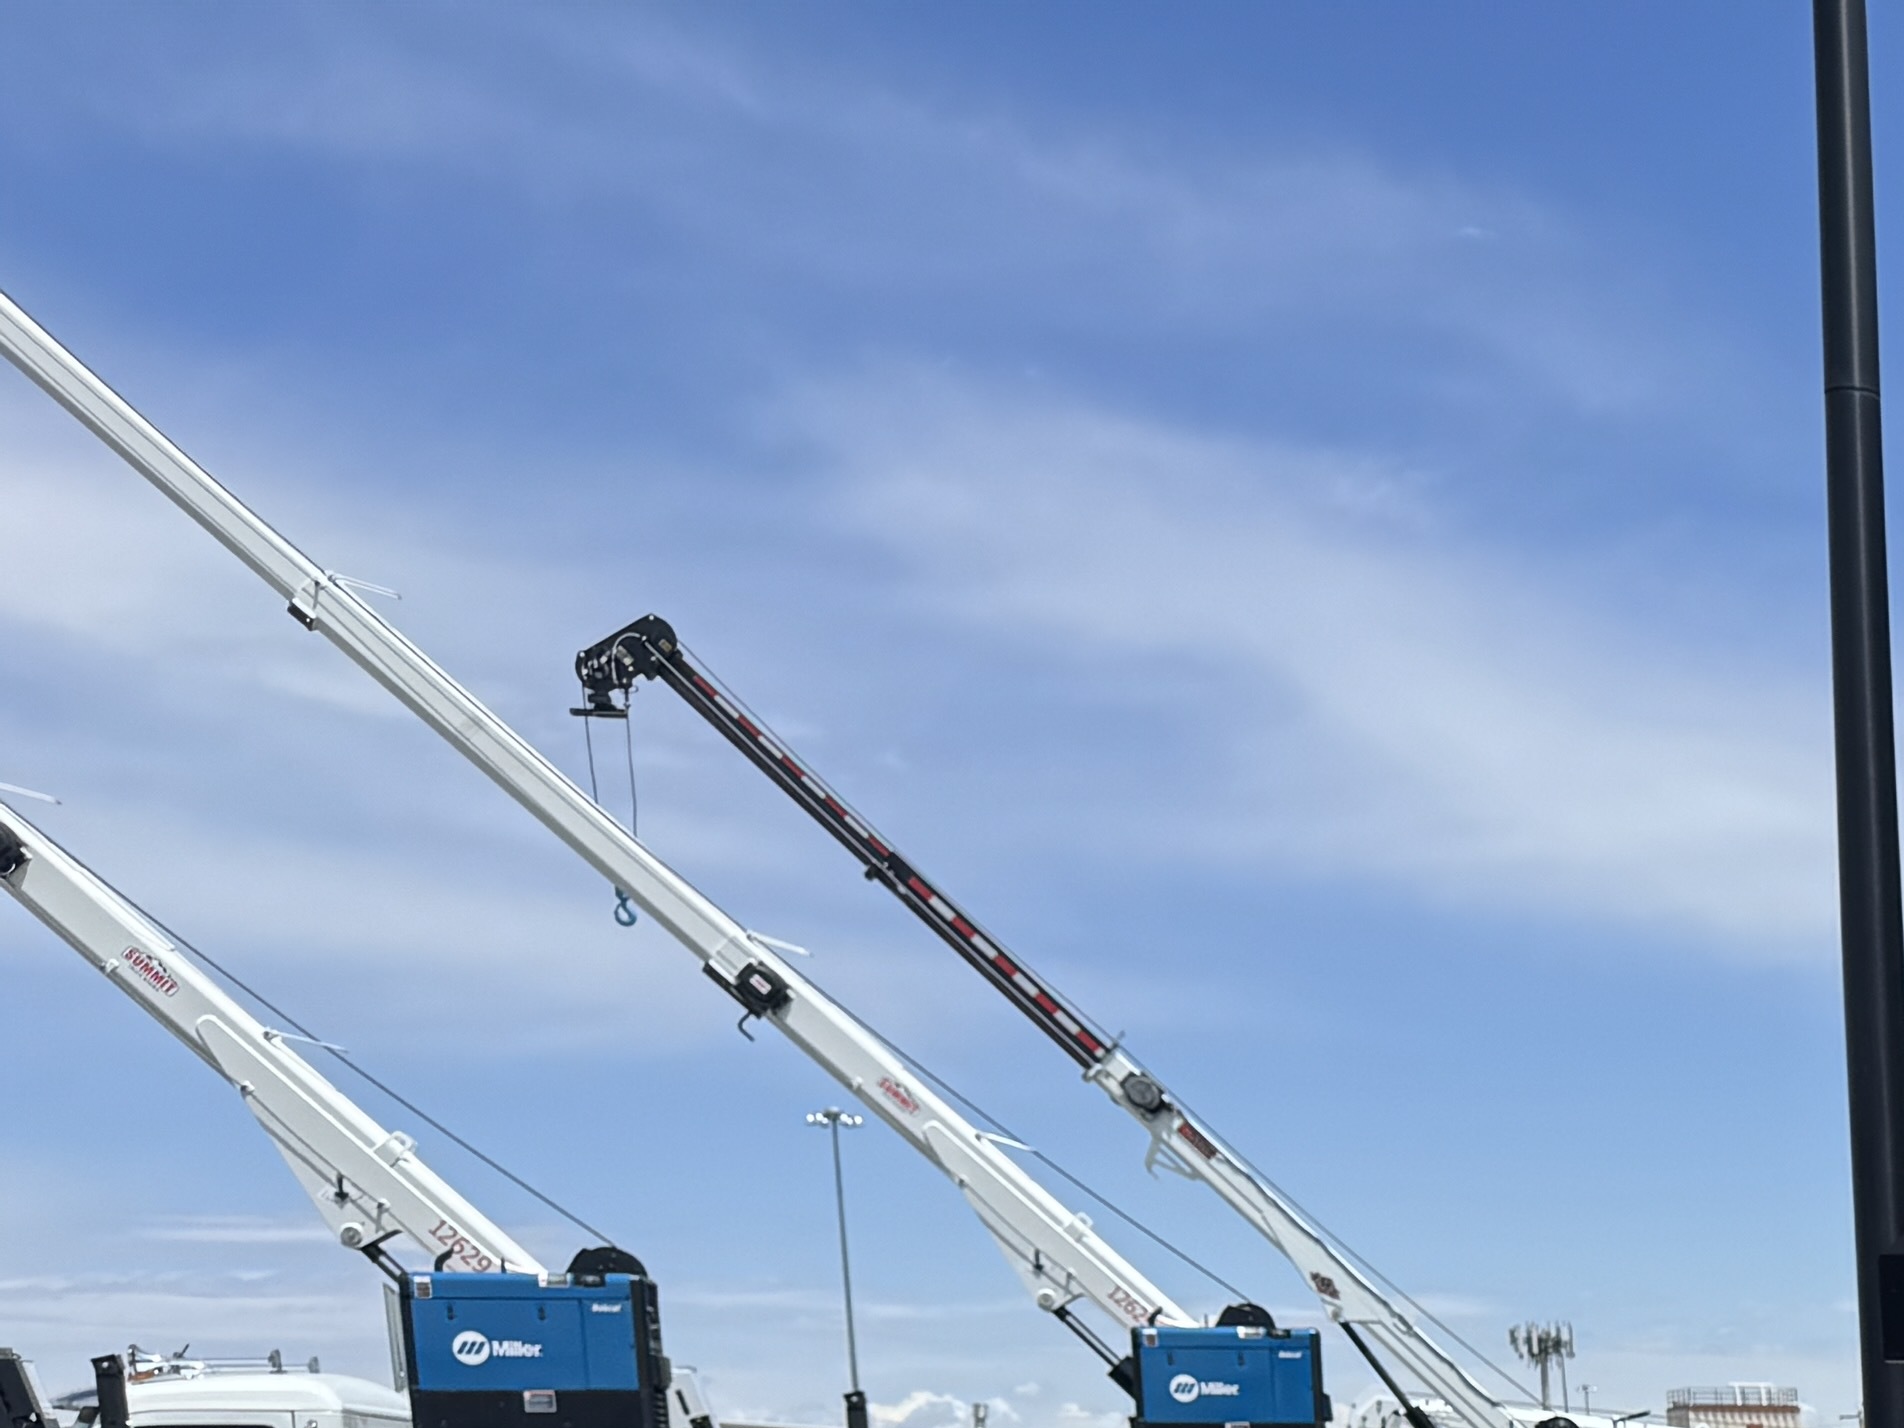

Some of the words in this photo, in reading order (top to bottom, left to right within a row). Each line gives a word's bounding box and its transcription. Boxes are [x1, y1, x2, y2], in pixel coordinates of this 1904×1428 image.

[124, 948, 178, 993] SUMMIT
[428, 1219, 492, 1274] 12629
[1107, 1285, 1150, 1324] 1262
[492, 1340, 541, 1358] Miller
[1200, 1381, 1239, 1396] Miller
